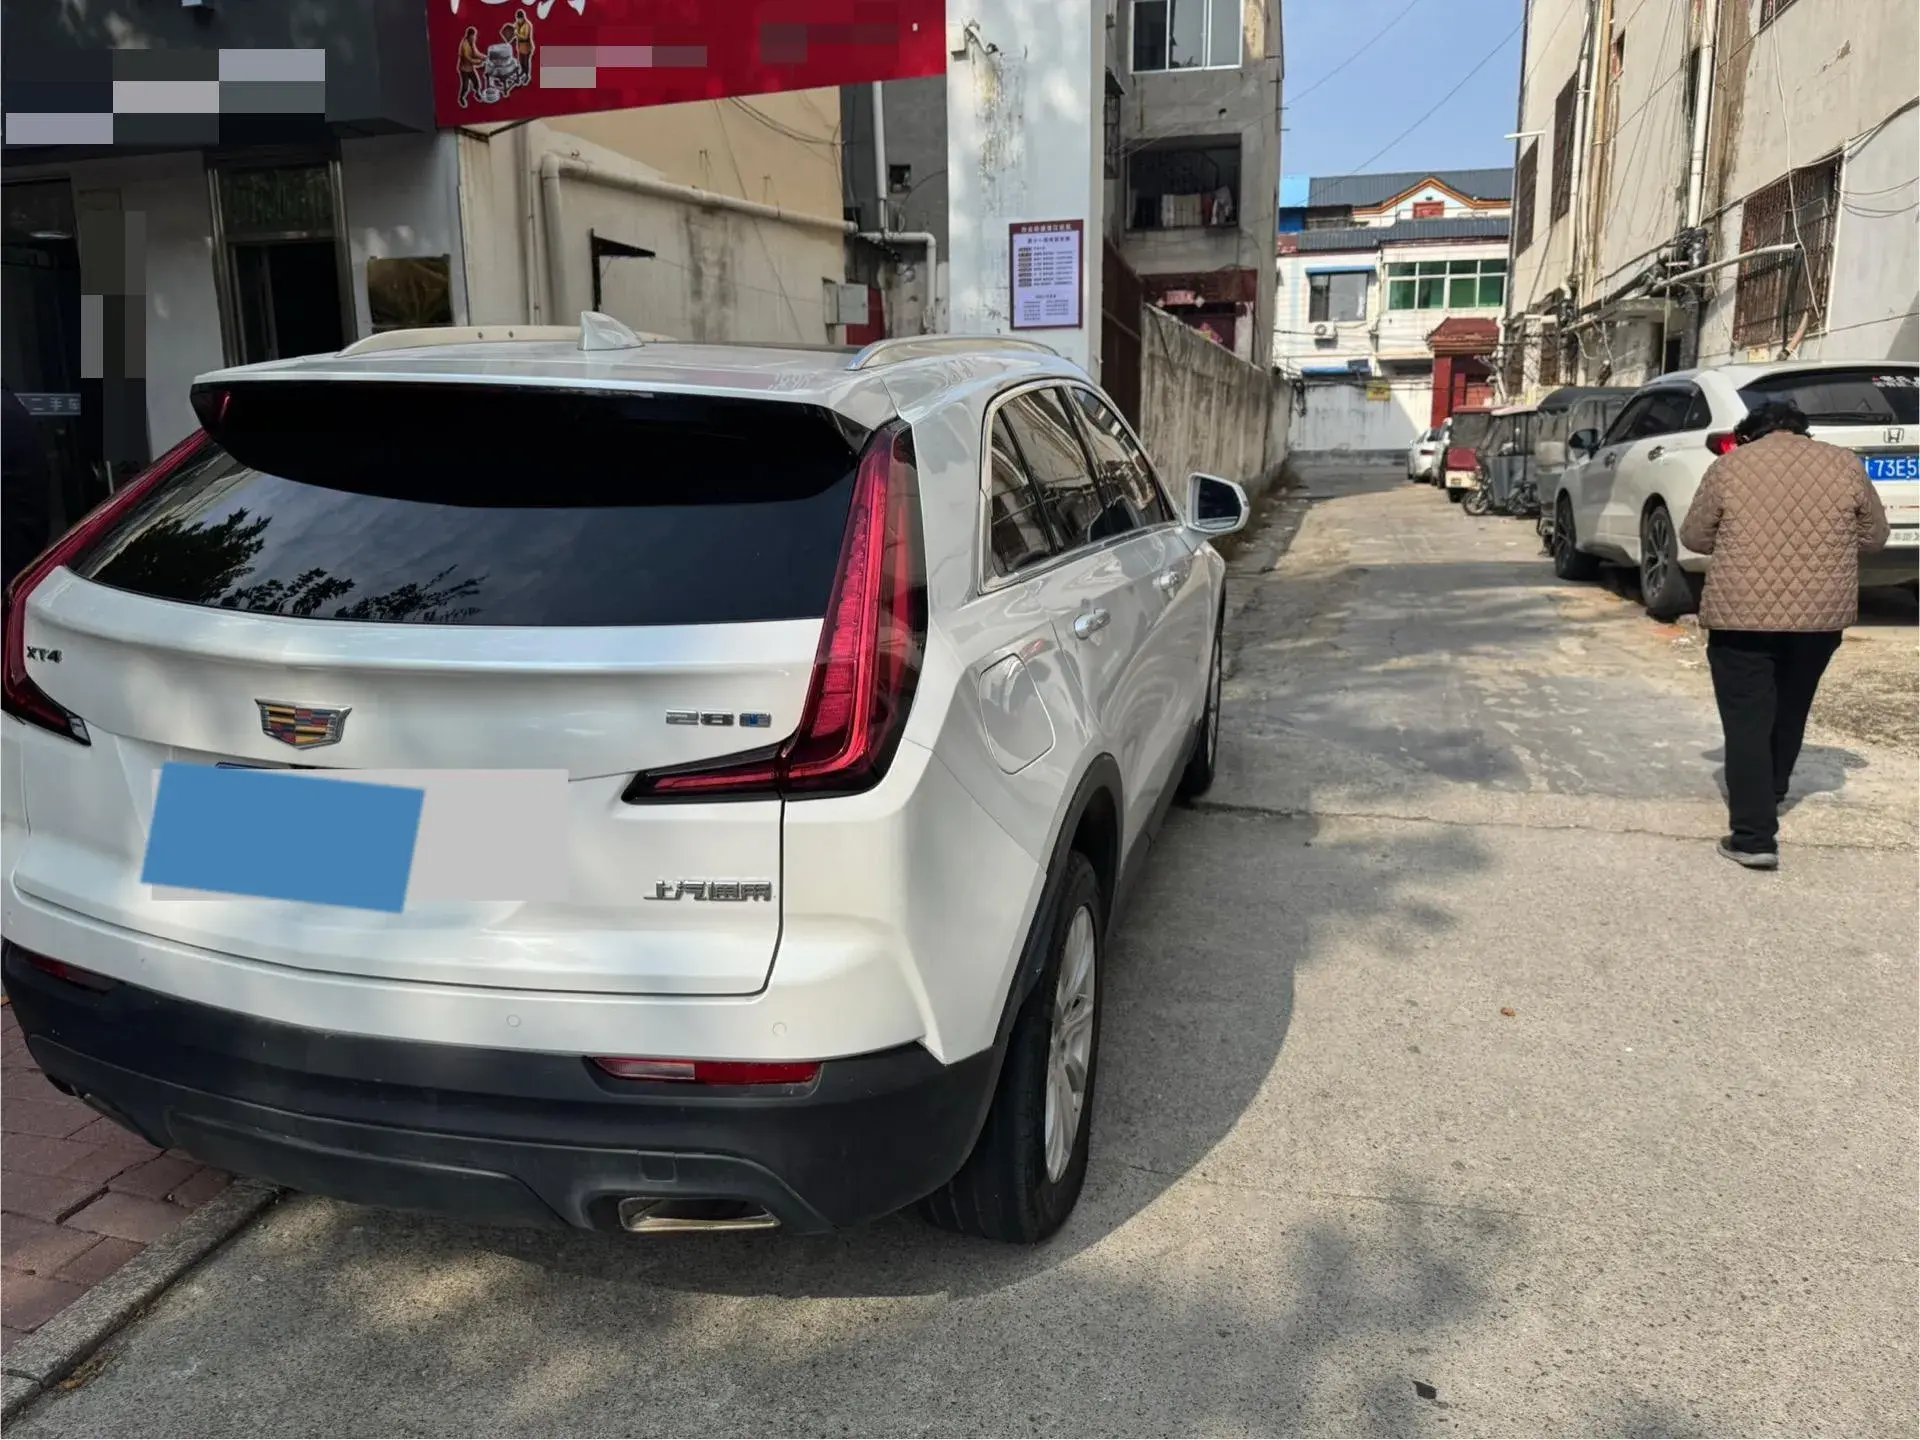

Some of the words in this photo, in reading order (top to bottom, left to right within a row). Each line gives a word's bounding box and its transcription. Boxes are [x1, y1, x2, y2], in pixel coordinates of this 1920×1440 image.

[1865, 458, 1918, 478] 73E5
[26, 645, 62, 663] XT4
[643, 879, 772, 902] 上汽通用
